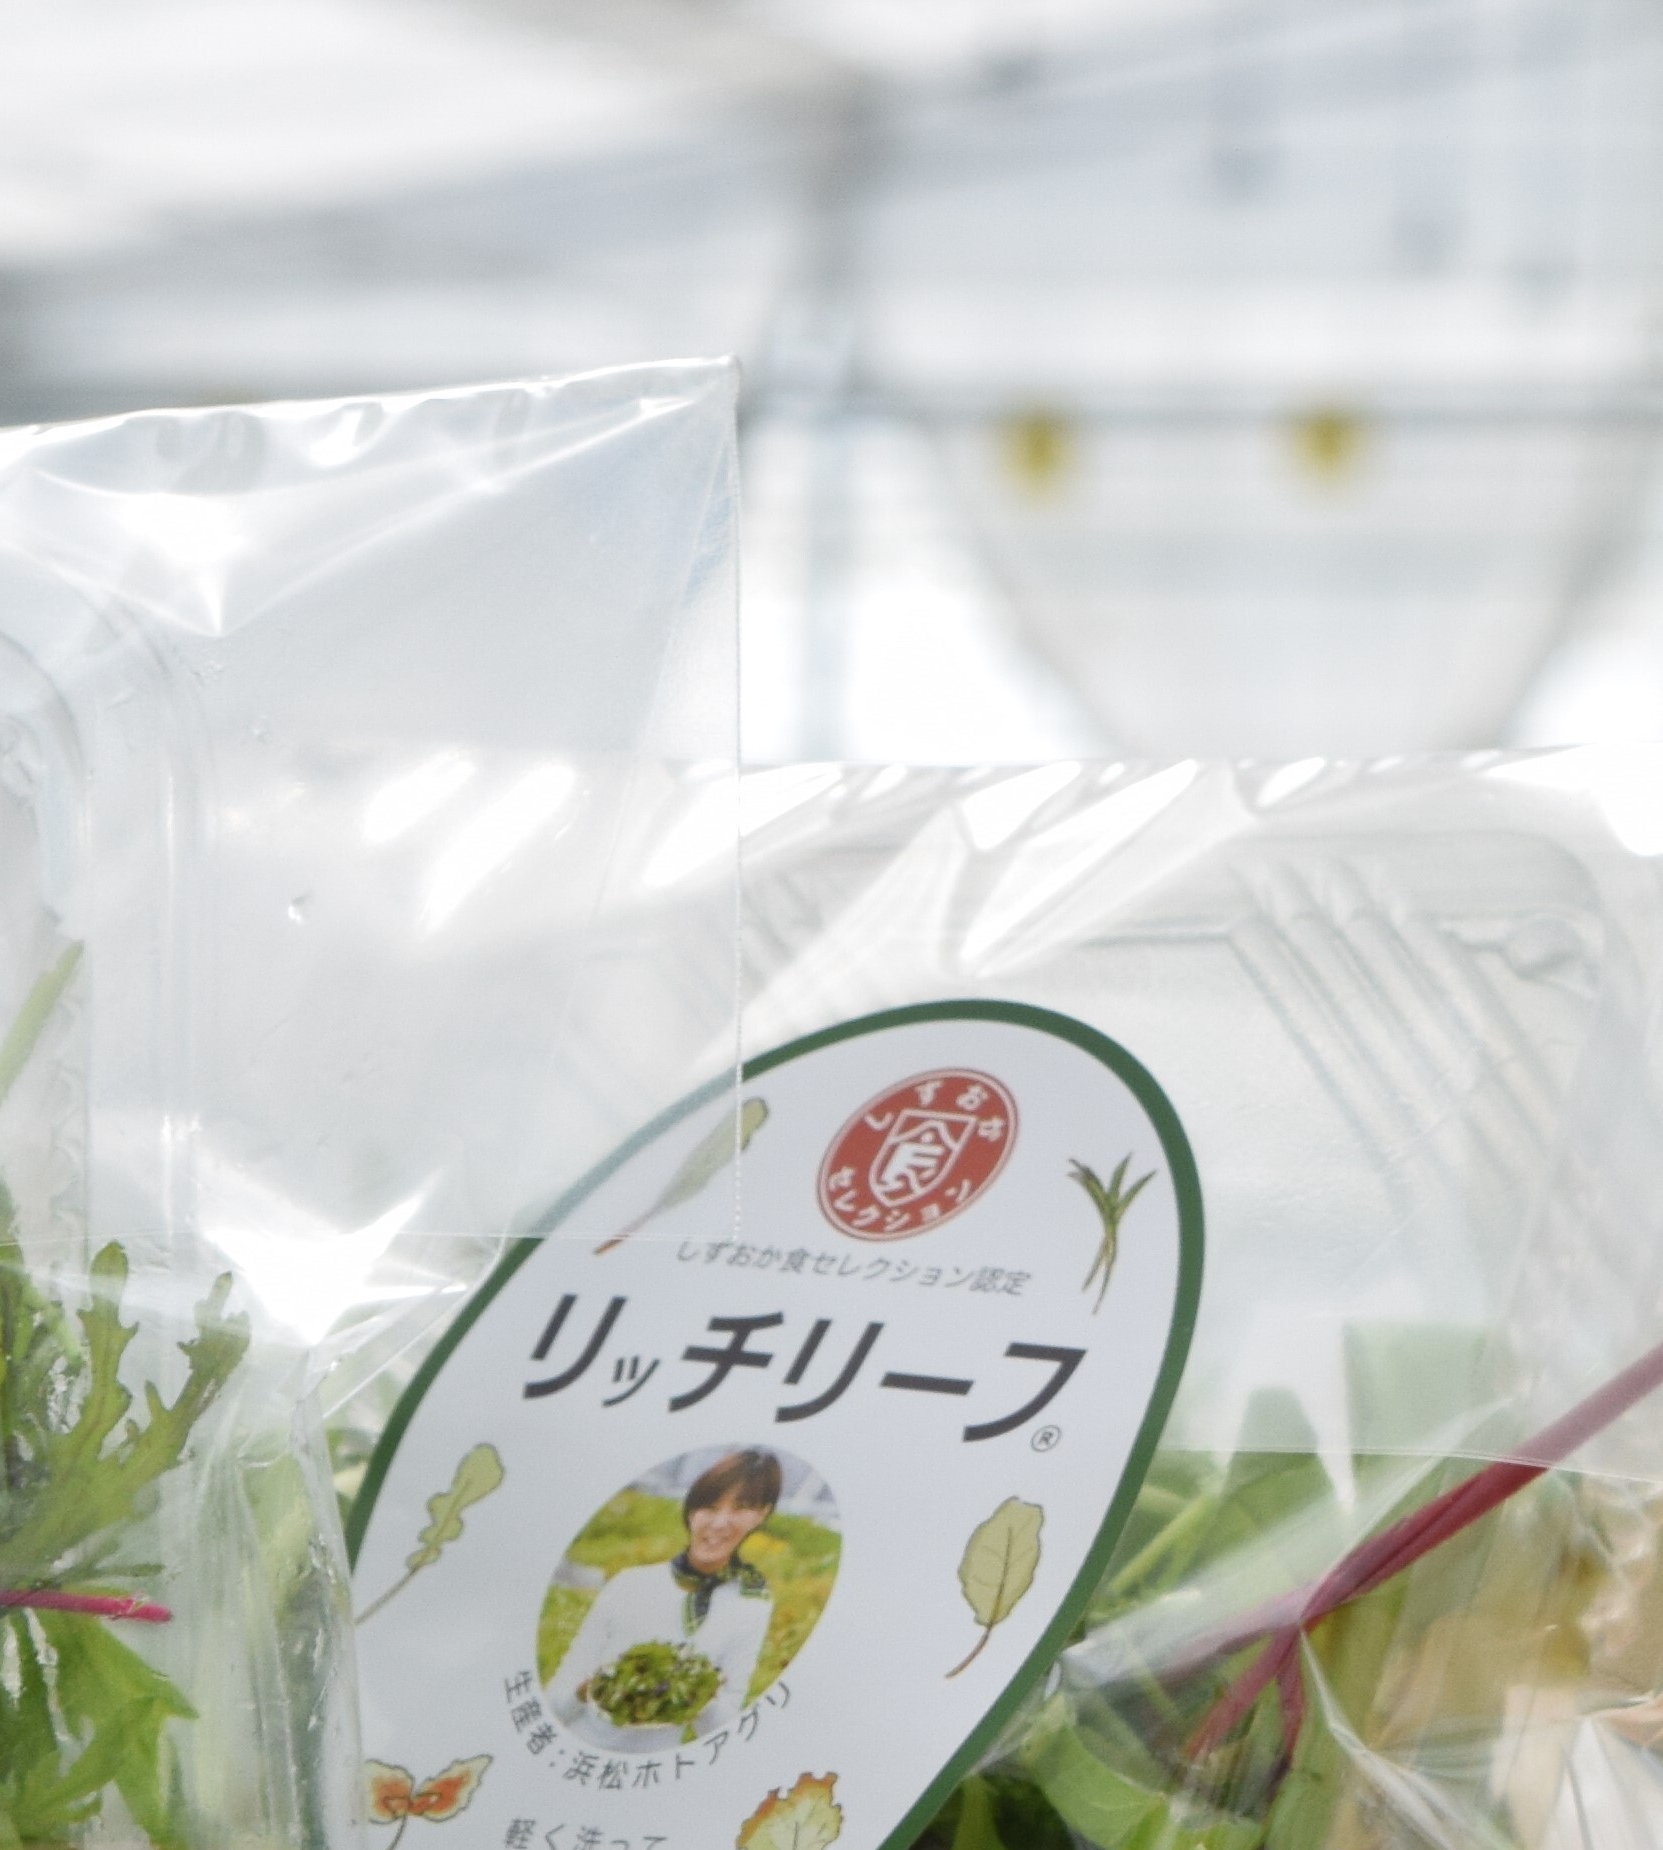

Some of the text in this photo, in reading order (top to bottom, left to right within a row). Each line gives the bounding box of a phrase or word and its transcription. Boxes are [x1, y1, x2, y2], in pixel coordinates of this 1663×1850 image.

[675, 1240, 1032, 1297] しずおか食セレクション認定
